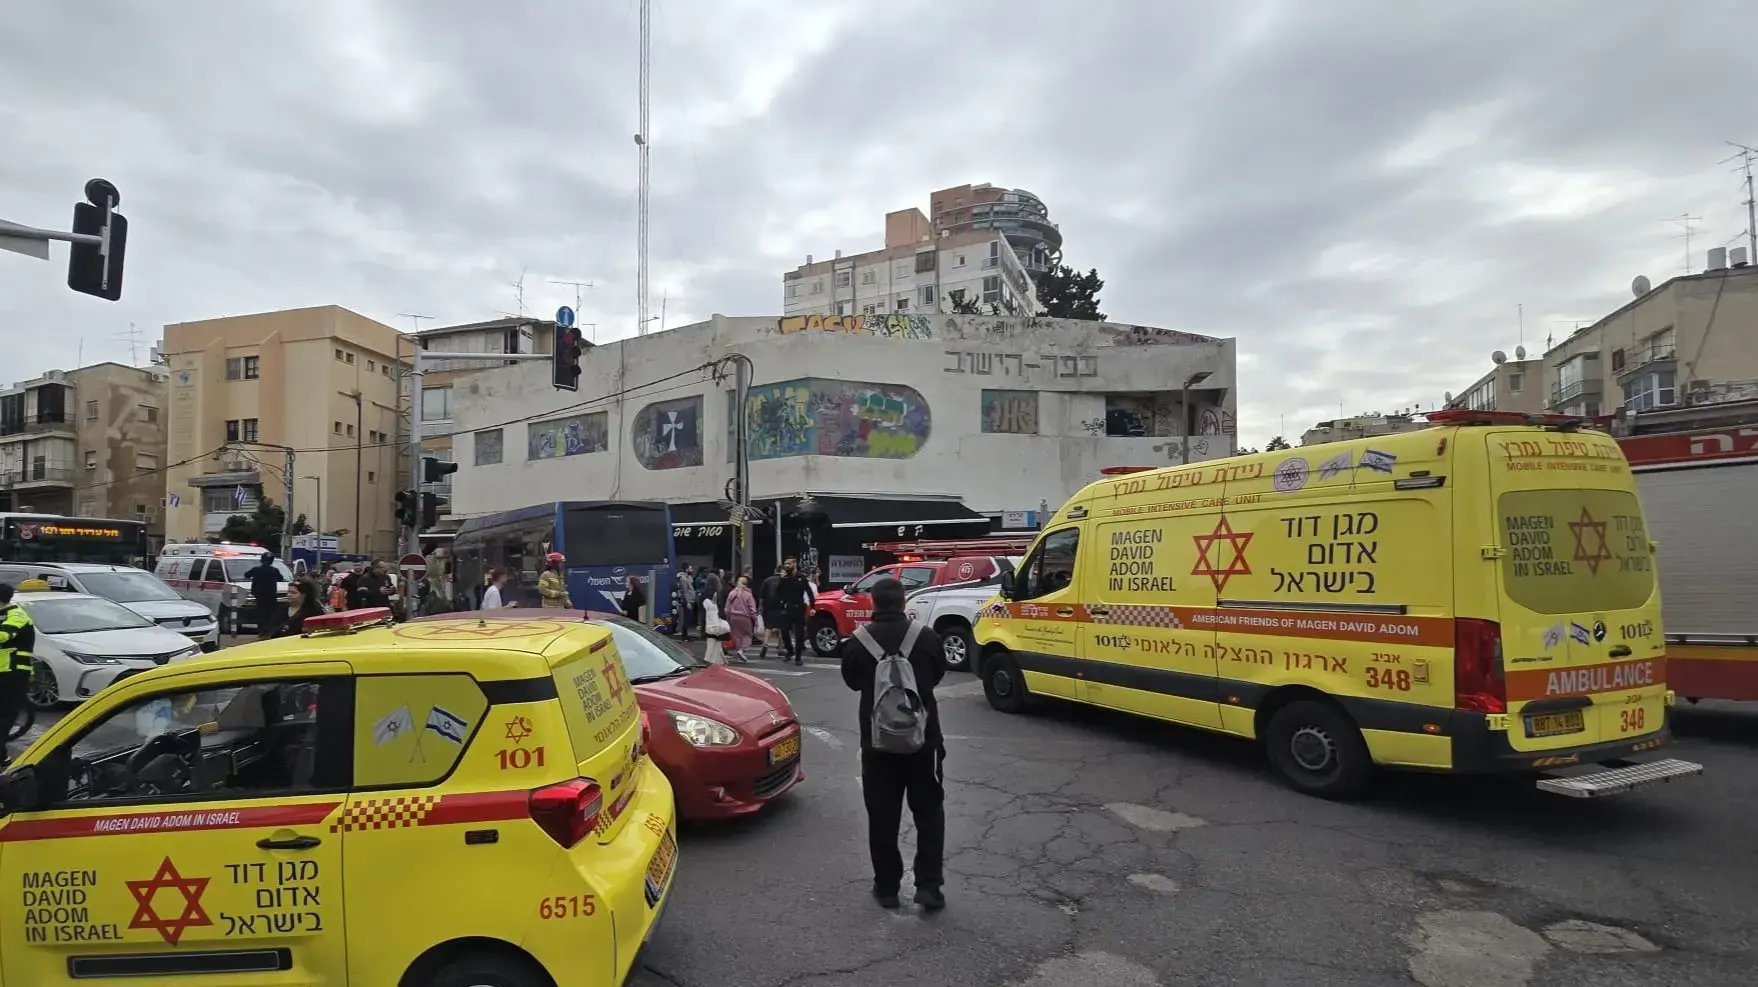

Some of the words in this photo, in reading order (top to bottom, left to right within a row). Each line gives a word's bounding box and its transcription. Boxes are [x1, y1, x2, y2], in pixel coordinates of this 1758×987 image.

[1499, 441, 1542, 462] נמרץ
[1546, 438, 1588, 458] טיפול
[1213, 462, 1264, 483] ניידת
[1506, 462, 1542, 471] MOBILE
[1547, 462, 1587, 471] INTENSIVE
[1113, 480, 1145, 500] נמרץ
[1157, 470, 1202, 490] טיפול
[1112, 506, 1144, 517] MOBILE
[1147, 500, 1197, 514] INTENSIVE
[1201, 498, 1229, 509] CARE
[1235, 494, 1262, 505] UNIT
[698, 526, 723, 537] סטוק
[1280, 516, 1319, 538] דוד
[1333, 512, 1379, 540] מגן
[1506, 516, 1553, 530] MAGEN
[1111, 529, 1163, 545] MAGEN
[1509, 531, 1550, 546] DAVID
[1110, 547, 1153, 560] DAVID
[1308, 541, 1377, 564] אדום
[1513, 546, 1553, 561] ADOM
[1110, 561, 1153, 576] ADOM
[1513, 563, 1530, 577] IN
[1534, 560, 1573, 576] ISRAEL
[1109, 578, 1124, 591] IN
[1127, 576, 1176, 591] ISRAEL
[1271, 568, 1375, 594] בישראל
[1192, 614, 1237, 626] AMERICAN
[1239, 616, 1279, 628] FRIENDS
[1281, 618, 1294, 629] OF
[1297, 619, 1338, 631] MAGEN
[1339, 621, 1376, 633] DAVID
[1379, 623, 1419, 636] ADOM
[1620, 623, 1642, 639] 101
[1095, 634, 1119, 647] 101
[1134, 639, 1196, 659] הלאומי
[1204, 642, 1273, 666] ההצלה
[1284, 651, 1348, 674] ארגון
[1372, 651, 1401, 664] אביב
[573, 669, 596, 688] MAGEN
[1366, 667, 1410, 692] 348
[1546, 662, 1652, 696] AMBULANCE
[577, 682, 598, 700] DAVID
[585, 711, 595, 724] IN
[1620, 708, 1644, 732] 348
[494, 747, 544, 769] 101
[94, 818, 131, 832] MAGEN
[132, 816, 161, 830] DAVID
[162, 815, 191, 828] ADOM
[193, 814, 205, 826] IN
[206, 812, 240, 825] ISRAEL
[23, 870, 96, 888] MAGEN
[224, 863, 265, 884] דוד
[278, 860, 319, 886] מגן
[23, 889, 86, 906] DAVID
[256, 886, 321, 908] אדום
[25, 907, 88, 925] ADOM
[539, 895, 596, 920] 6515
[26, 926, 46, 942] IN
[55, 924, 124, 941] ISRAEL
[220, 913, 323, 935] בישראל
